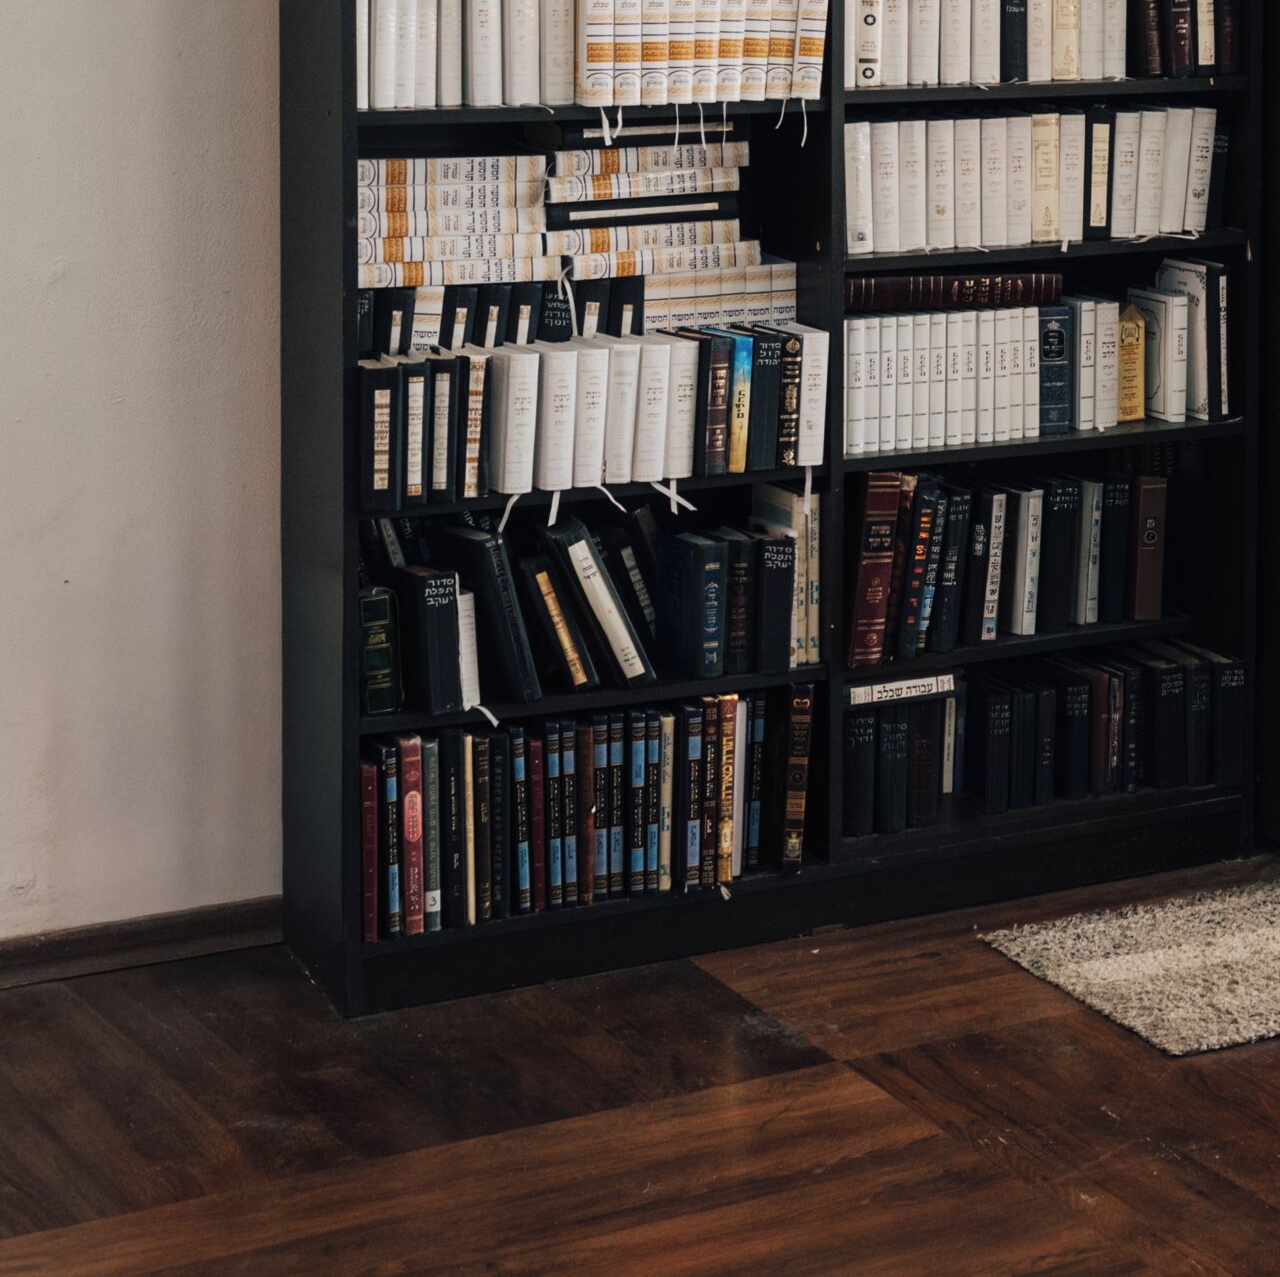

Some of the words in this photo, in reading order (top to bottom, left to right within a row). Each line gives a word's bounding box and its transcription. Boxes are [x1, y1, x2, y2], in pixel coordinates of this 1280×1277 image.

[723, 309, 744, 318] חמשה
[773, 305, 795, 314] חמשה
[646, 315, 668, 323] חמשה
[697, 311, 720, 320] חמשה
[413, 330, 438, 339] חמשה
[759, 350, 781, 358] קול
[756, 358, 781, 366] יהודה
[735, 390, 746, 419] תהלים
[765, 545, 792, 553] סדור
[764, 552, 792, 561] תפלת
[765, 560, 791, 570] יעקב
[425, 587, 453, 596] תפלת
[426, 596, 453, 607] יעקב
[877, 685, 903, 699] שבלב
[906, 683, 933, 694] עבודה
